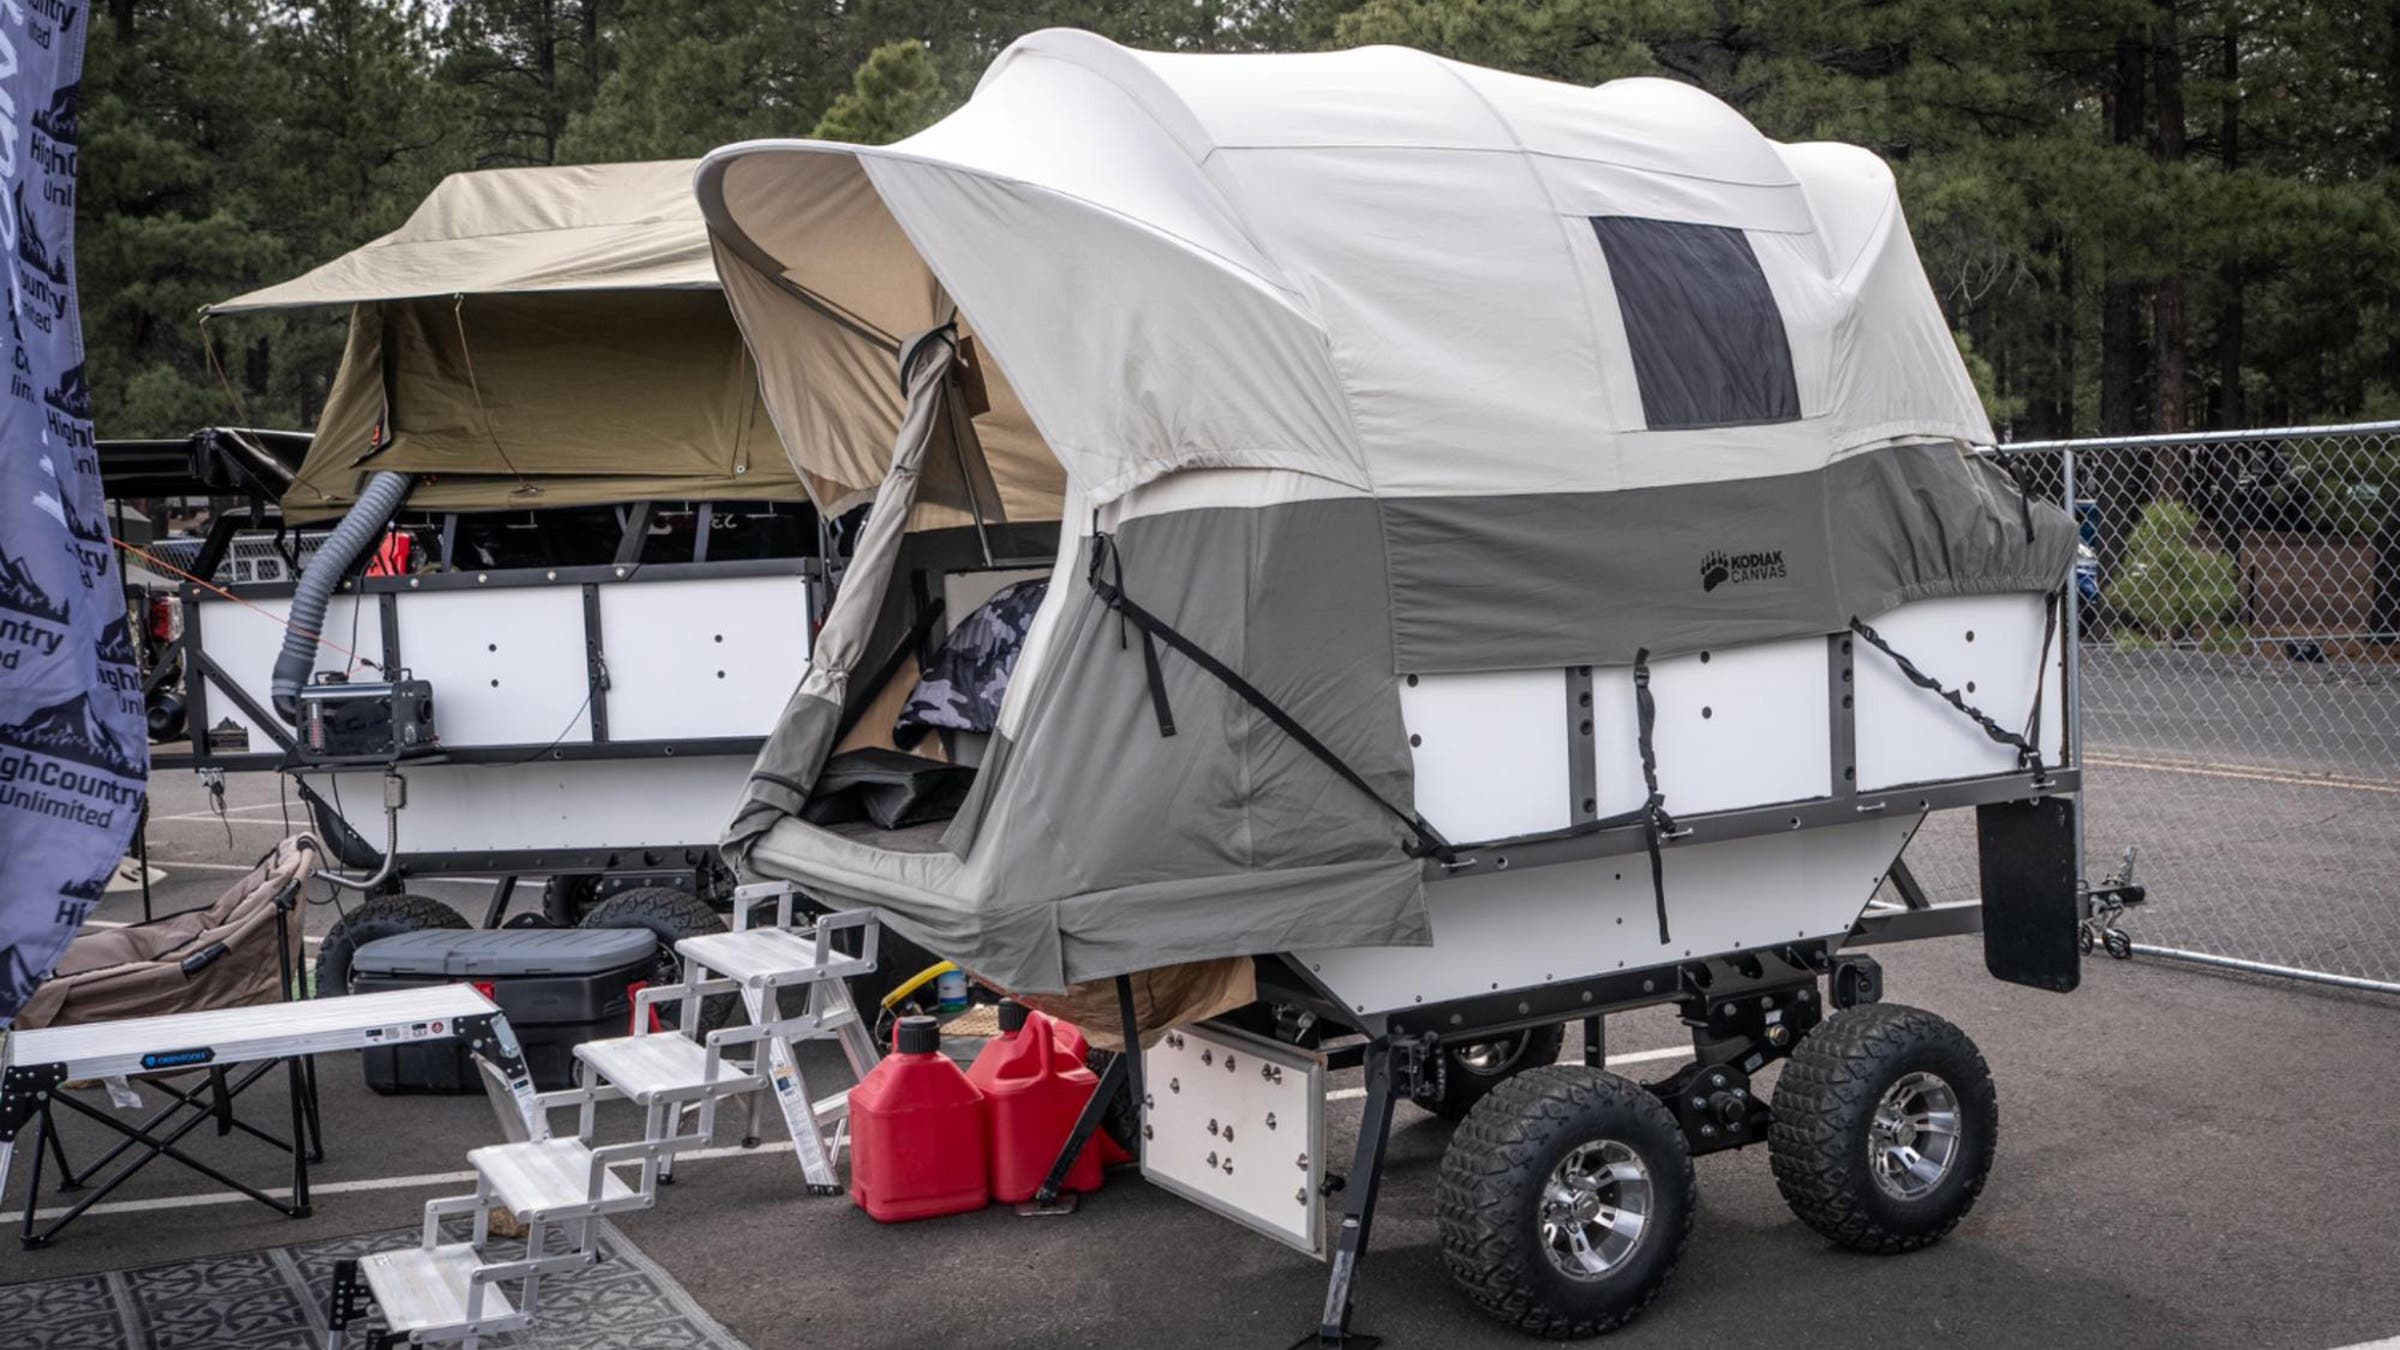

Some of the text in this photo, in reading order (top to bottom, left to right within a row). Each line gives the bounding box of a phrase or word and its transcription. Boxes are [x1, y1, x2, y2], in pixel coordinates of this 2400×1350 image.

[1731, 550, 1784, 570] KODIAK
[1731, 564, 1786, 583] CANVAS
[0, 784, 115, 829] Unlimited
